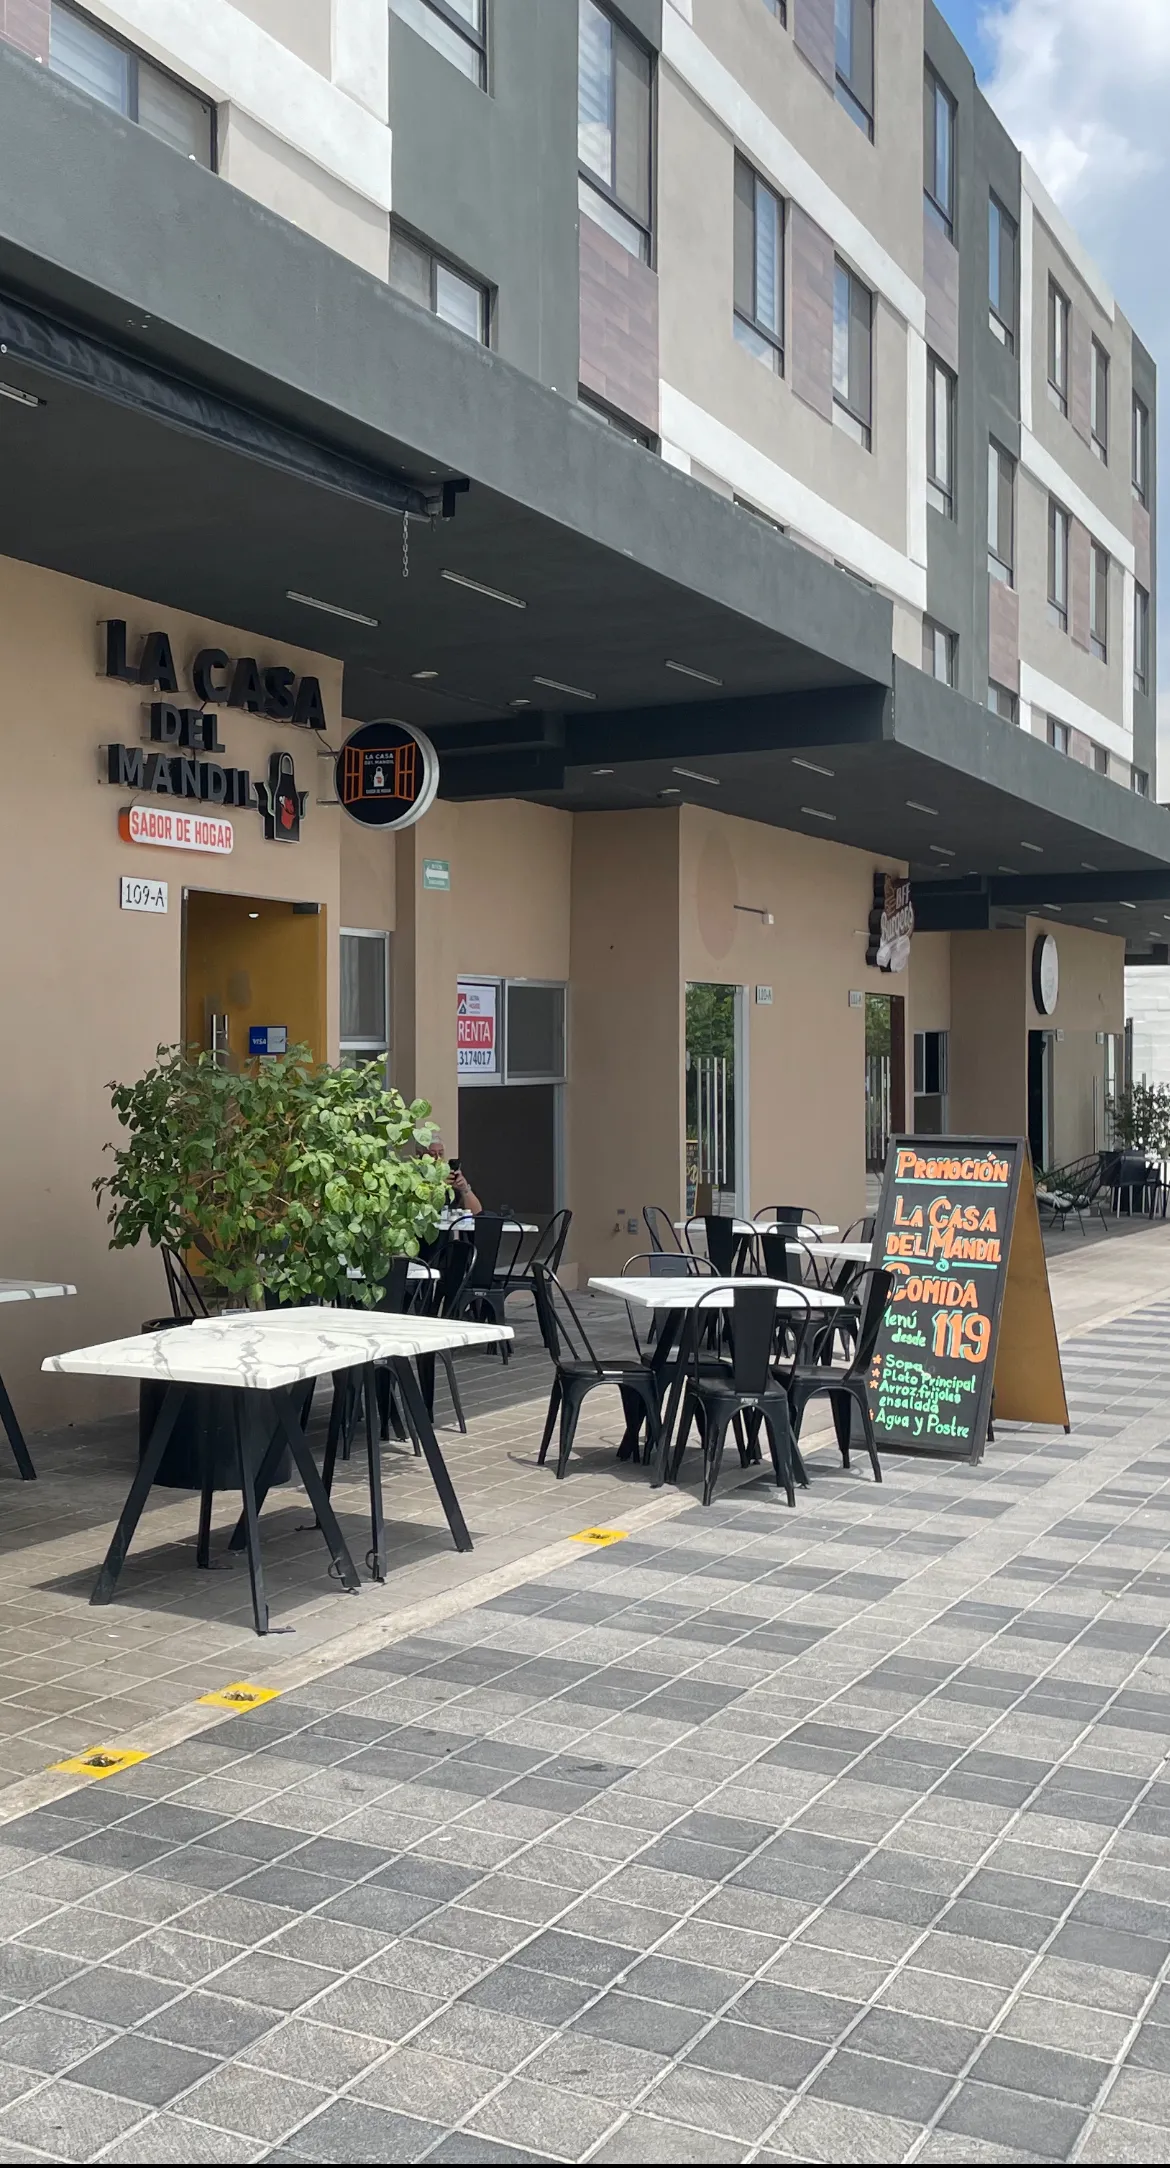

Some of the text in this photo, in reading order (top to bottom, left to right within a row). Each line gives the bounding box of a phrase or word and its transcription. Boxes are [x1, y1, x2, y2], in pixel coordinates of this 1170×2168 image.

[106, 619, 327, 730] LA CASA
[151, 702, 226, 753] DEL
[108, 743, 258, 808] MANDIL
[131, 811, 232, 849] SABOR DE HOGAR
[126, 884, 165, 907] 109-A
[458, 1020, 491, 1042] RENTA
[457, 1050, 492, 1066] 3174017
[891, 1309, 992, 1363] desde 119
[885, 1353, 923, 1372] Sopa
[920, 1371, 977, 1394] Principal
[878, 1395, 939, 1414] ensalada
[874, 1407, 970, 1438] Agua y Postre
